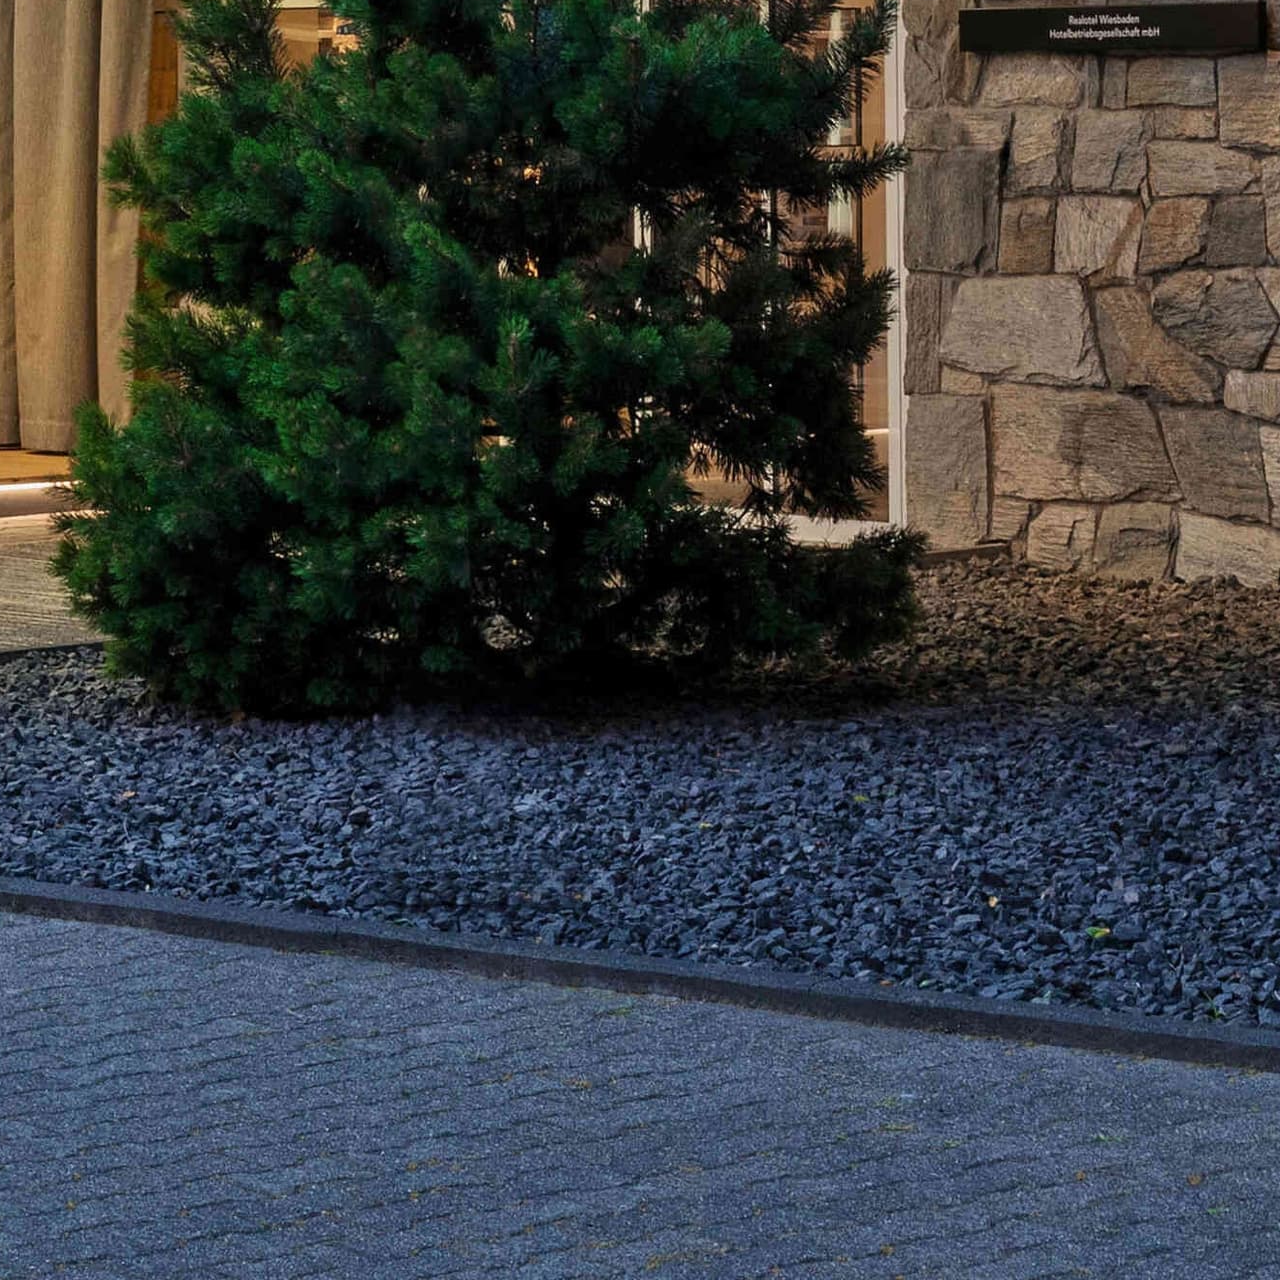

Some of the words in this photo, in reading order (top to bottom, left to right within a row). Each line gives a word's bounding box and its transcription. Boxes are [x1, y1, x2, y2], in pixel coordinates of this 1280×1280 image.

[1068, 14, 1099, 26] Realotel
[1099, 13, 1140, 25] Wiesbaden
[1049, 27, 1140, 40] Hotelbetriebsgesellschaft
[1141, 27, 1160, 38] mbH
